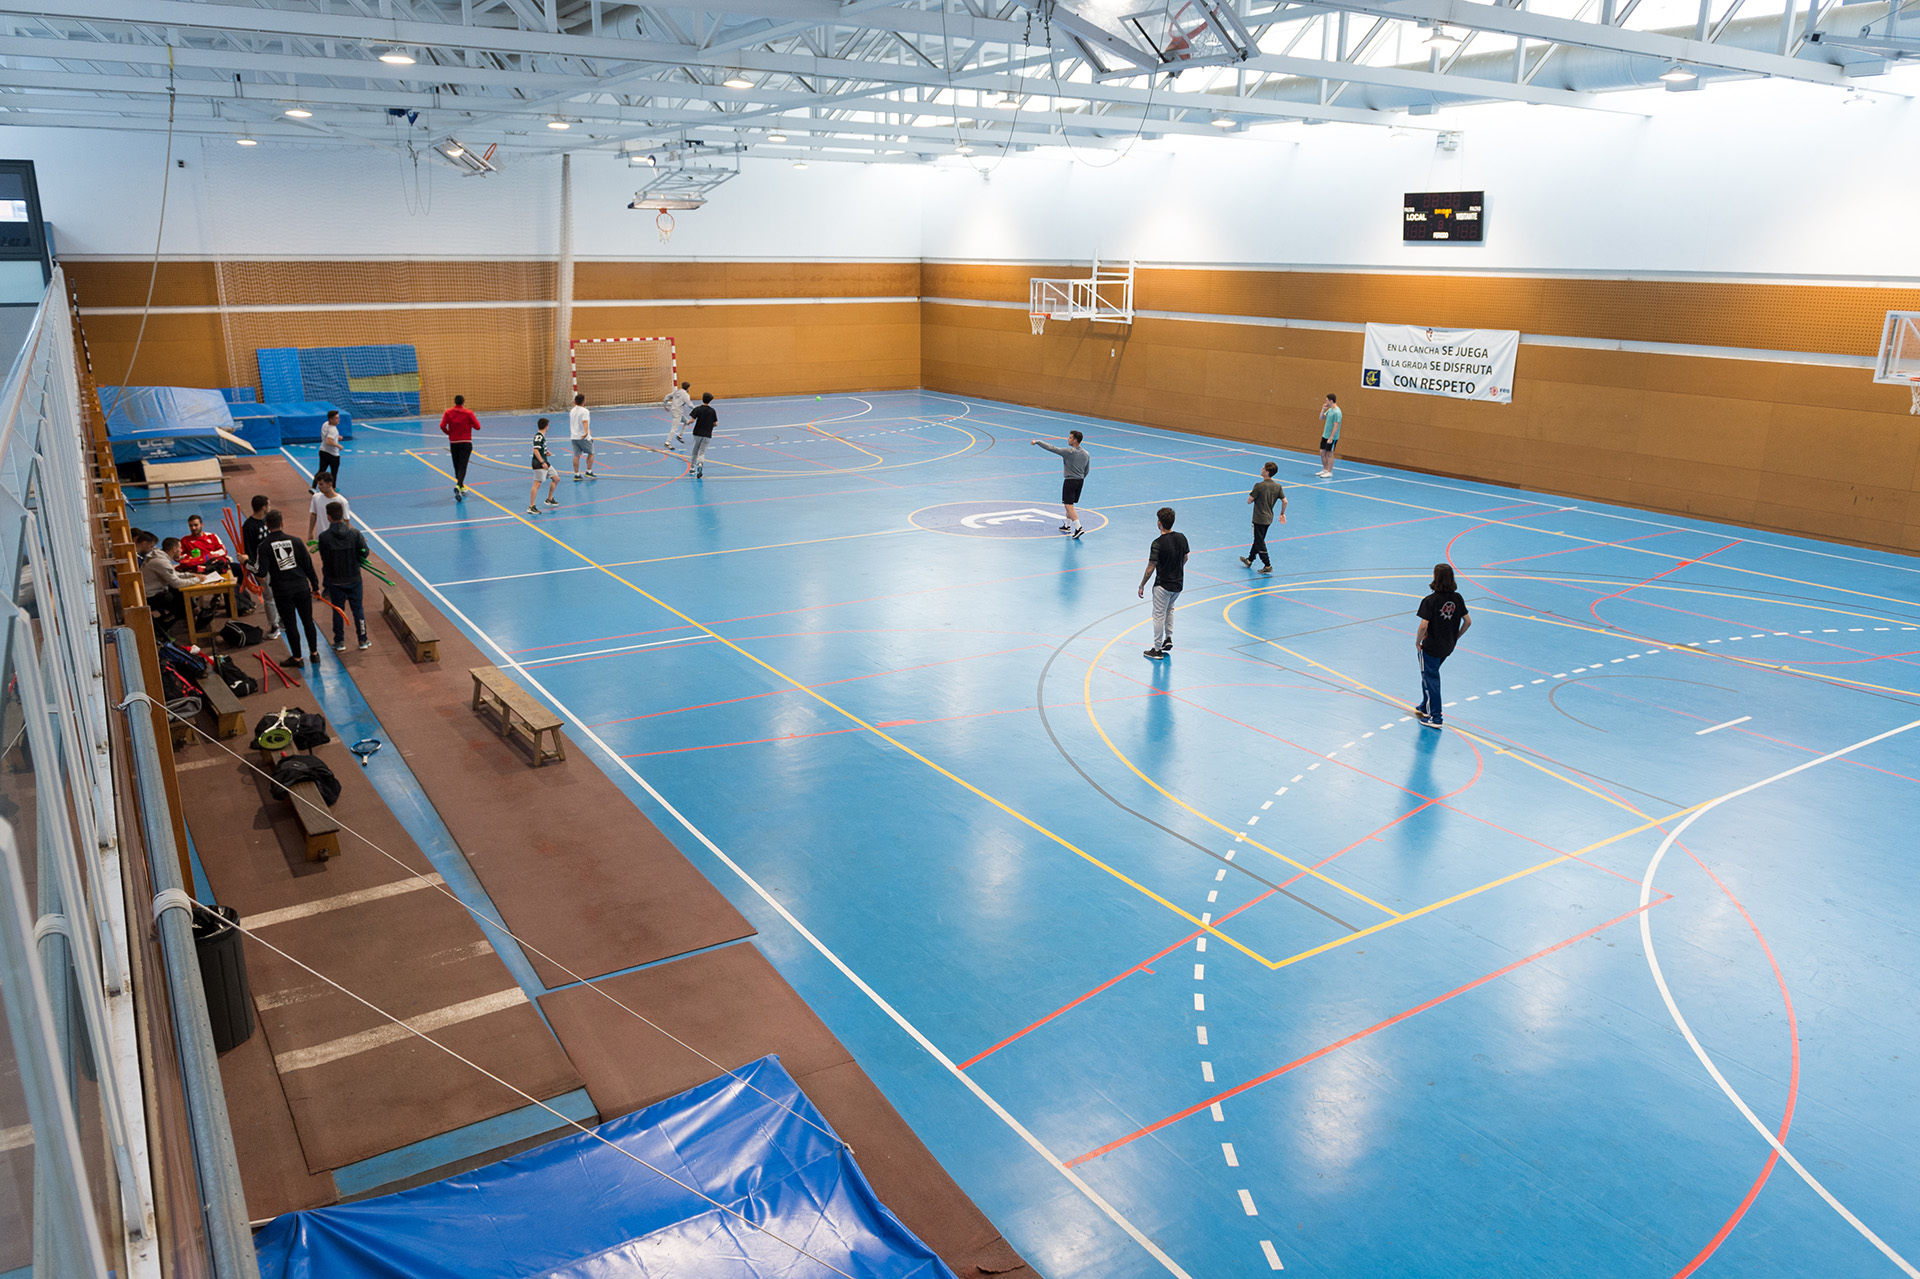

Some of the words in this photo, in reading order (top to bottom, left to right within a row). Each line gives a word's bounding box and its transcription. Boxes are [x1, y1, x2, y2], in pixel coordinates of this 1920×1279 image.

[1406, 213, 1427, 221] LOCAL
[1387, 343, 1397, 351] EN
[1398, 344, 1407, 352] LA
[1409, 345, 1439, 355] CANCHA
[1442, 345, 1453, 356] SE
[1455, 346, 1488, 358] JUEGA
[1381, 358, 1390, 367] EN
[1391, 360, 1400, 368] LA
[1401, 360, 1428, 370] GRADA
[1430, 360, 1441, 371] SE
[1443, 361, 1493, 375] DISFRUTA
[1393, 375, 1418, 388] CON
[1420, 377, 1475, 394] RESPETO
[137, 438, 174, 447] UCS
